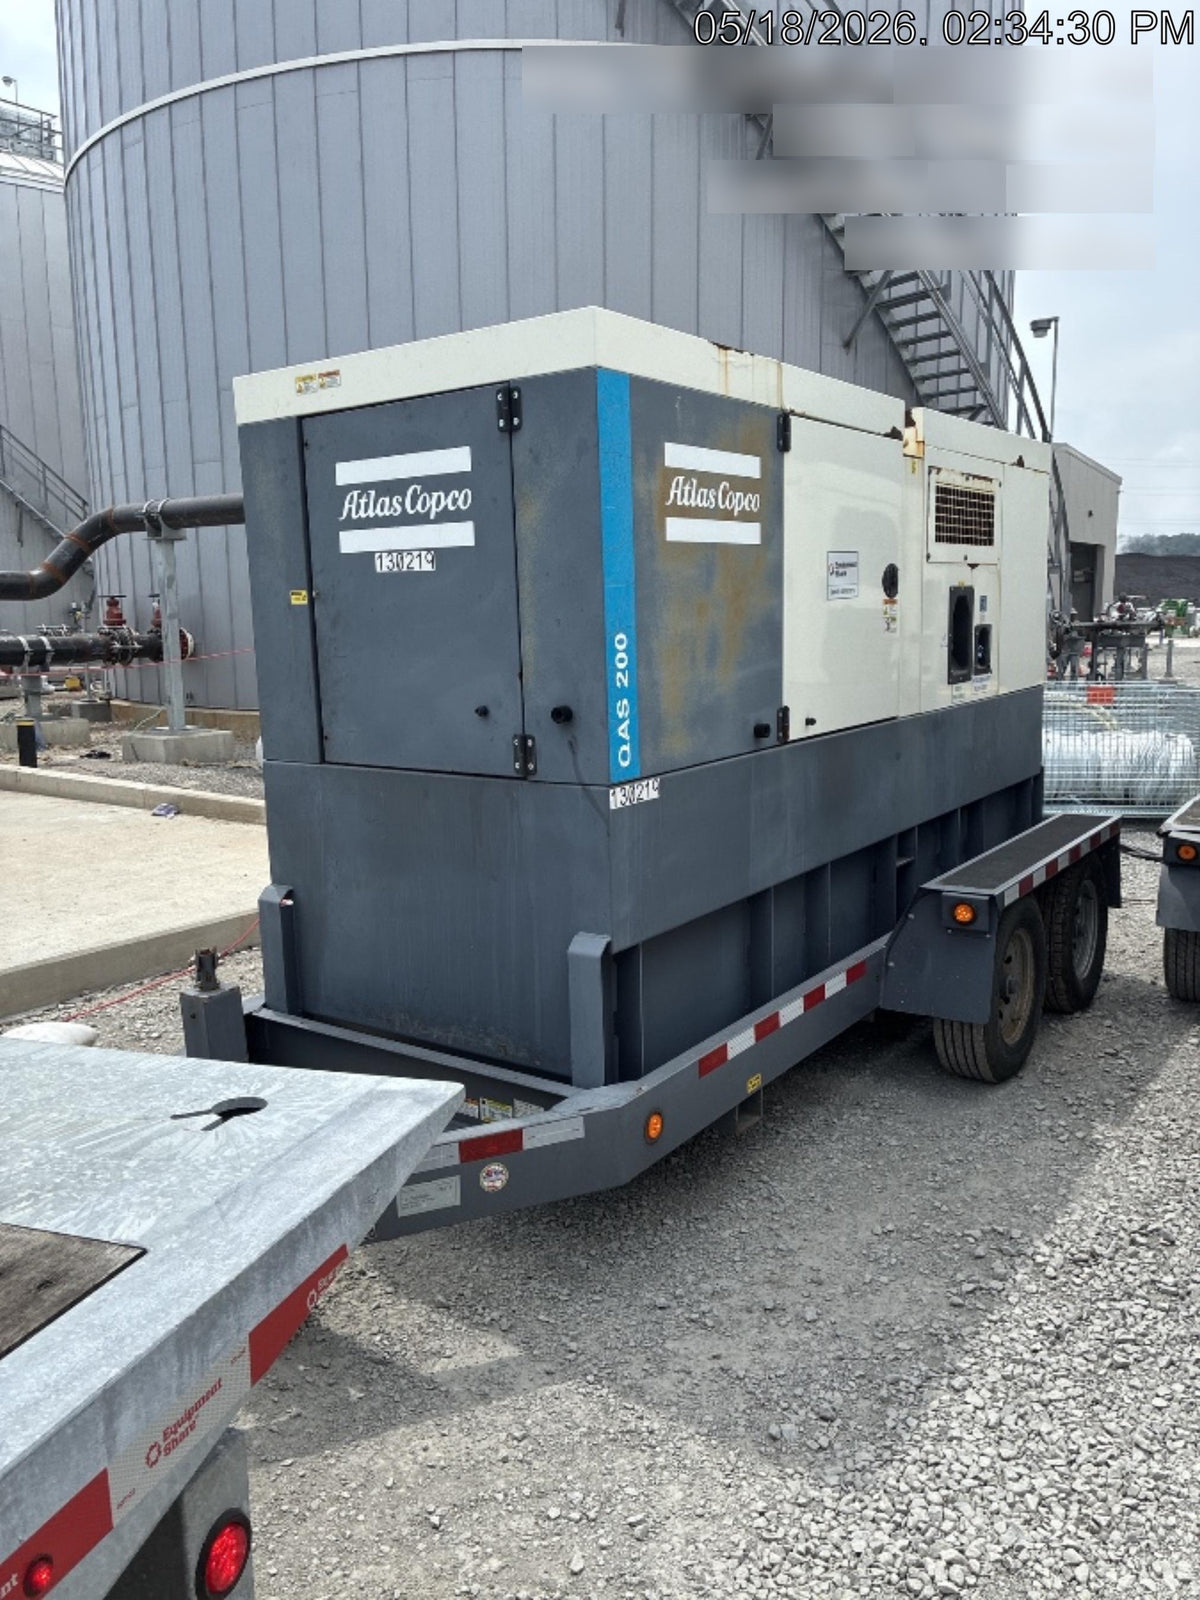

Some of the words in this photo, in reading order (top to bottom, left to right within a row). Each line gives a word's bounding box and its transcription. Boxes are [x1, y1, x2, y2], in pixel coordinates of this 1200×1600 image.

[338, 489, 403, 521] Atlas
[405, 484, 472, 520] Copco
[665, 475, 718, 510] Atlas
[718, 481, 761, 517] Copco
[375, 551, 436, 573] 130219
[614, 632, 629, 689] 200
[615, 698, 632, 769] QAS
[162, 1377, 224, 1443] Equipment
